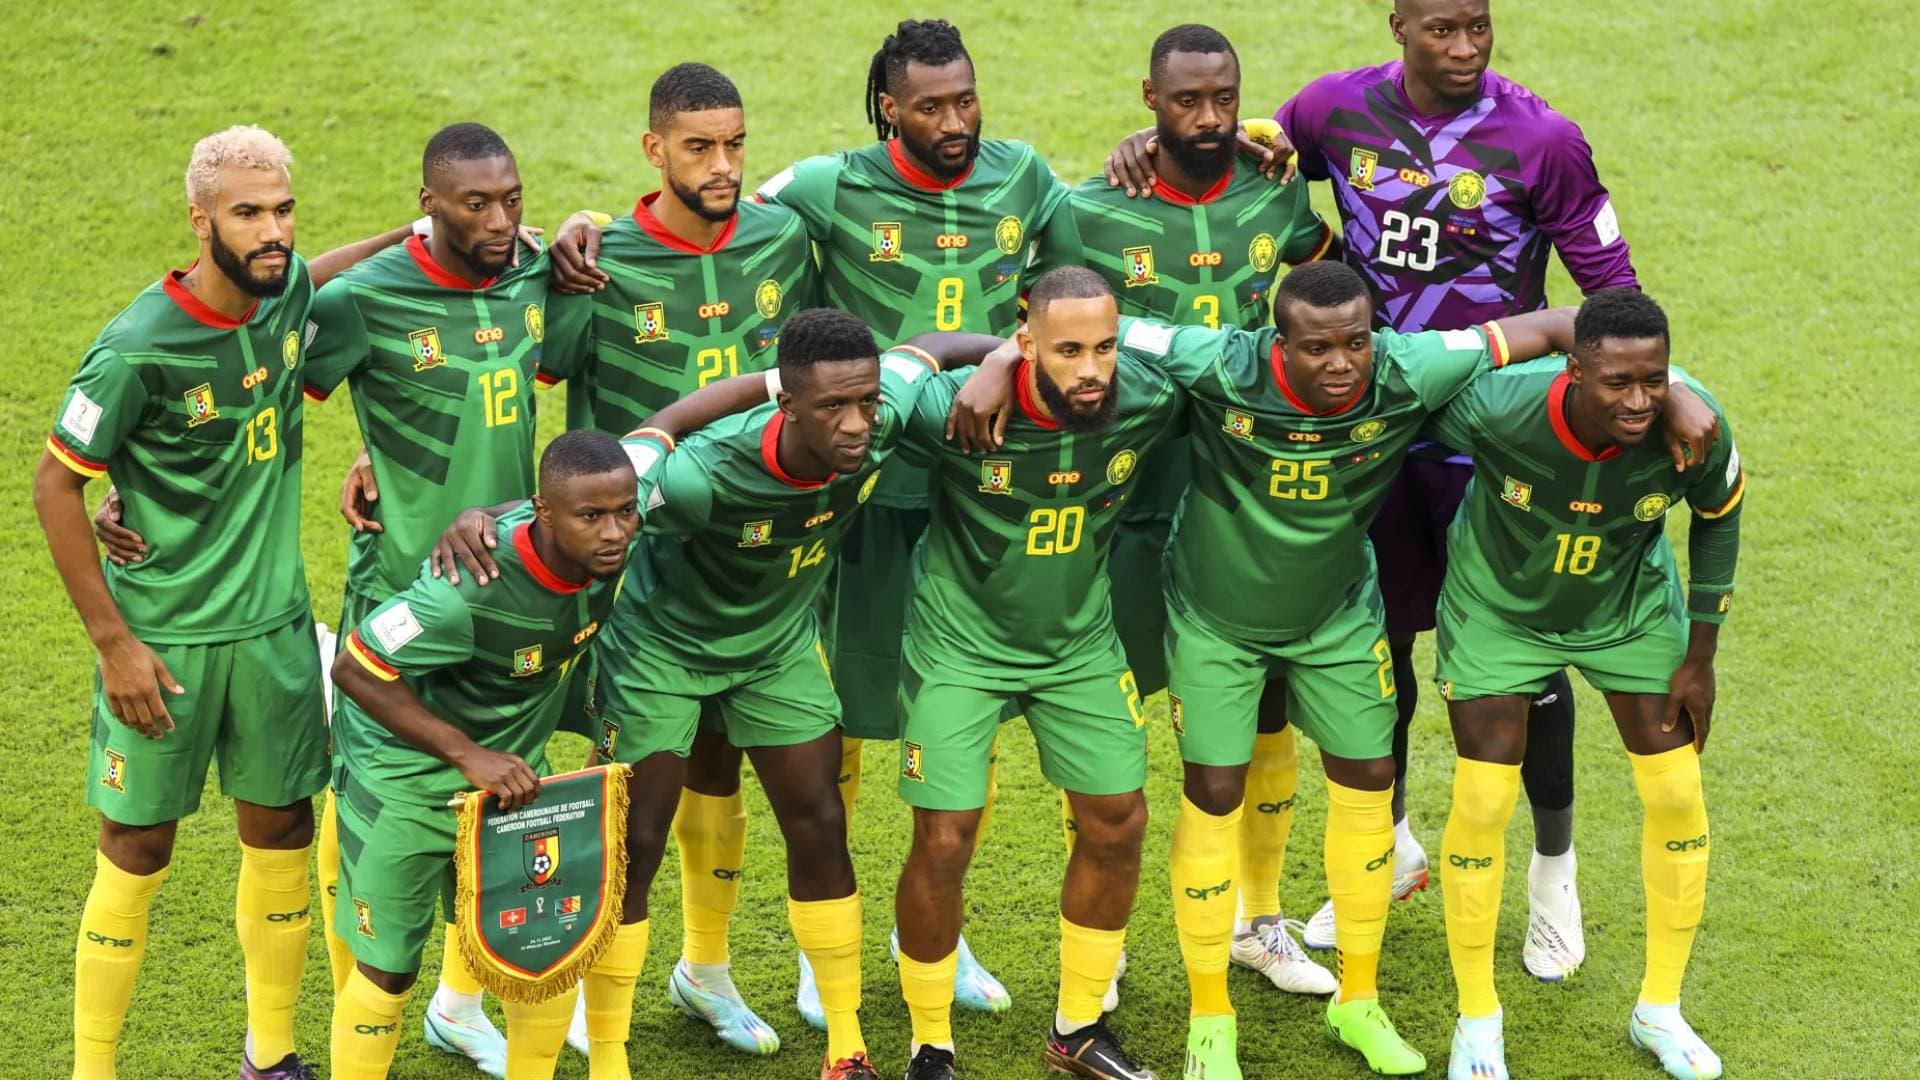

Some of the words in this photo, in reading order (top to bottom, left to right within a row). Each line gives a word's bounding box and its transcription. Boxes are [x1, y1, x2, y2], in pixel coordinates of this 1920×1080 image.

[1399, 167, 1431, 187] one
[936, 234, 968, 248] one
[1379, 209, 1440, 272] 23
[1189, 252, 1222, 267] one
[698, 301, 731, 319] one
[935, 277, 964, 332] 8
[1193, 294, 1220, 331] 3
[474, 326, 504, 344] one
[696, 344, 738, 388] 21
[242, 366, 268, 390] one
[478, 367, 518, 428] 12
[246, 406, 278, 466] 13
[1287, 431, 1322, 443] one
[1048, 470, 1081, 485] one
[1269, 458, 1331, 501] 25
[1569, 500, 1603, 514] one
[804, 510, 835, 528] one
[1025, 505, 1085, 556] 20
[787, 537, 827, 579] 14
[1552, 533, 1602, 576] 18
[573, 621, 598, 645] one
[560, 803, 568, 812] DE
[568, 798, 596, 811] FOOTBALL
[496, 822, 525, 834] CAMEROON
[526, 816, 553, 829] FOOTBALL
[553, 809, 586, 823] FEDERATION
[524, 829, 558, 841] CAMEROUN
[1666, 834, 1708, 852] one
[1365, 843, 1396, 872] on
[1448, 853, 1493, 870] one
[713, 868, 741, 881] on
[1185, 879, 1232, 901] one
[86, 930, 134, 947] one
[355, 1021, 397, 1036] one
